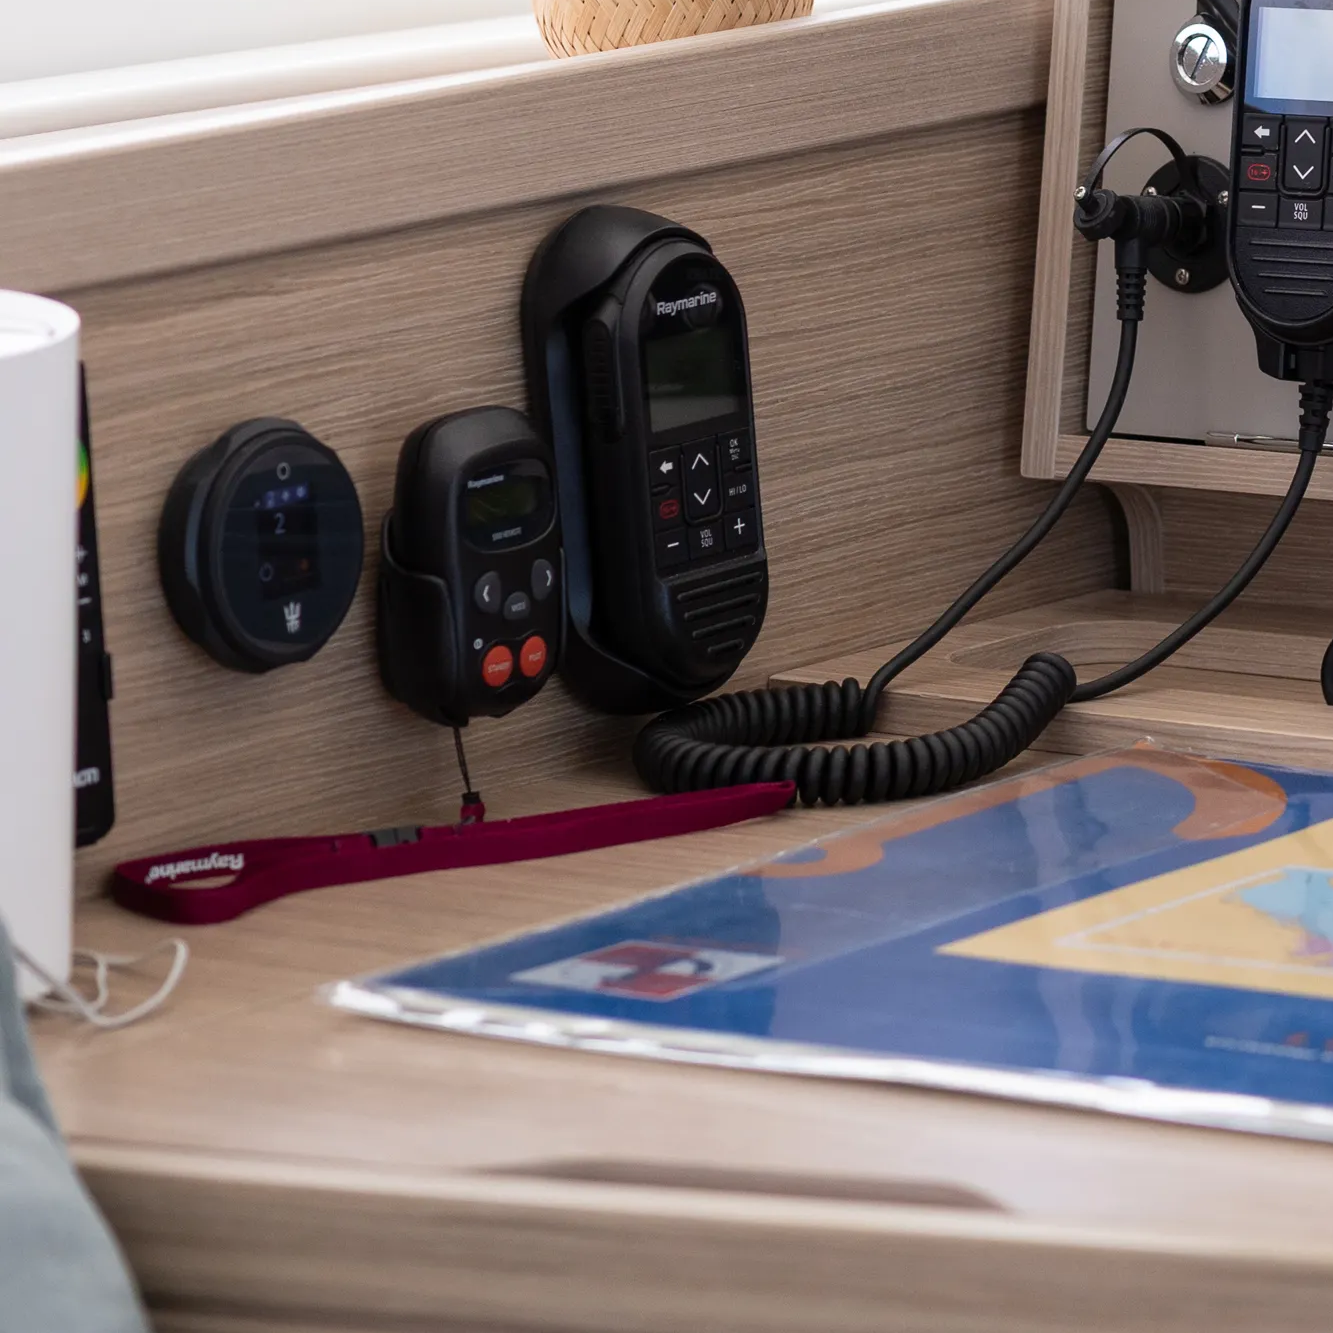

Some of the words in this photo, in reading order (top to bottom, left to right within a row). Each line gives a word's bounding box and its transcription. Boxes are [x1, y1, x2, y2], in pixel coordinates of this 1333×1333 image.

[1294, 203, 1308, 212] VOL
[1293, 212, 1308, 221] SQU
[656, 291, 717, 316] Raymarine
[700, 529, 712, 538] VOL
[701, 538, 713, 547] SQU
